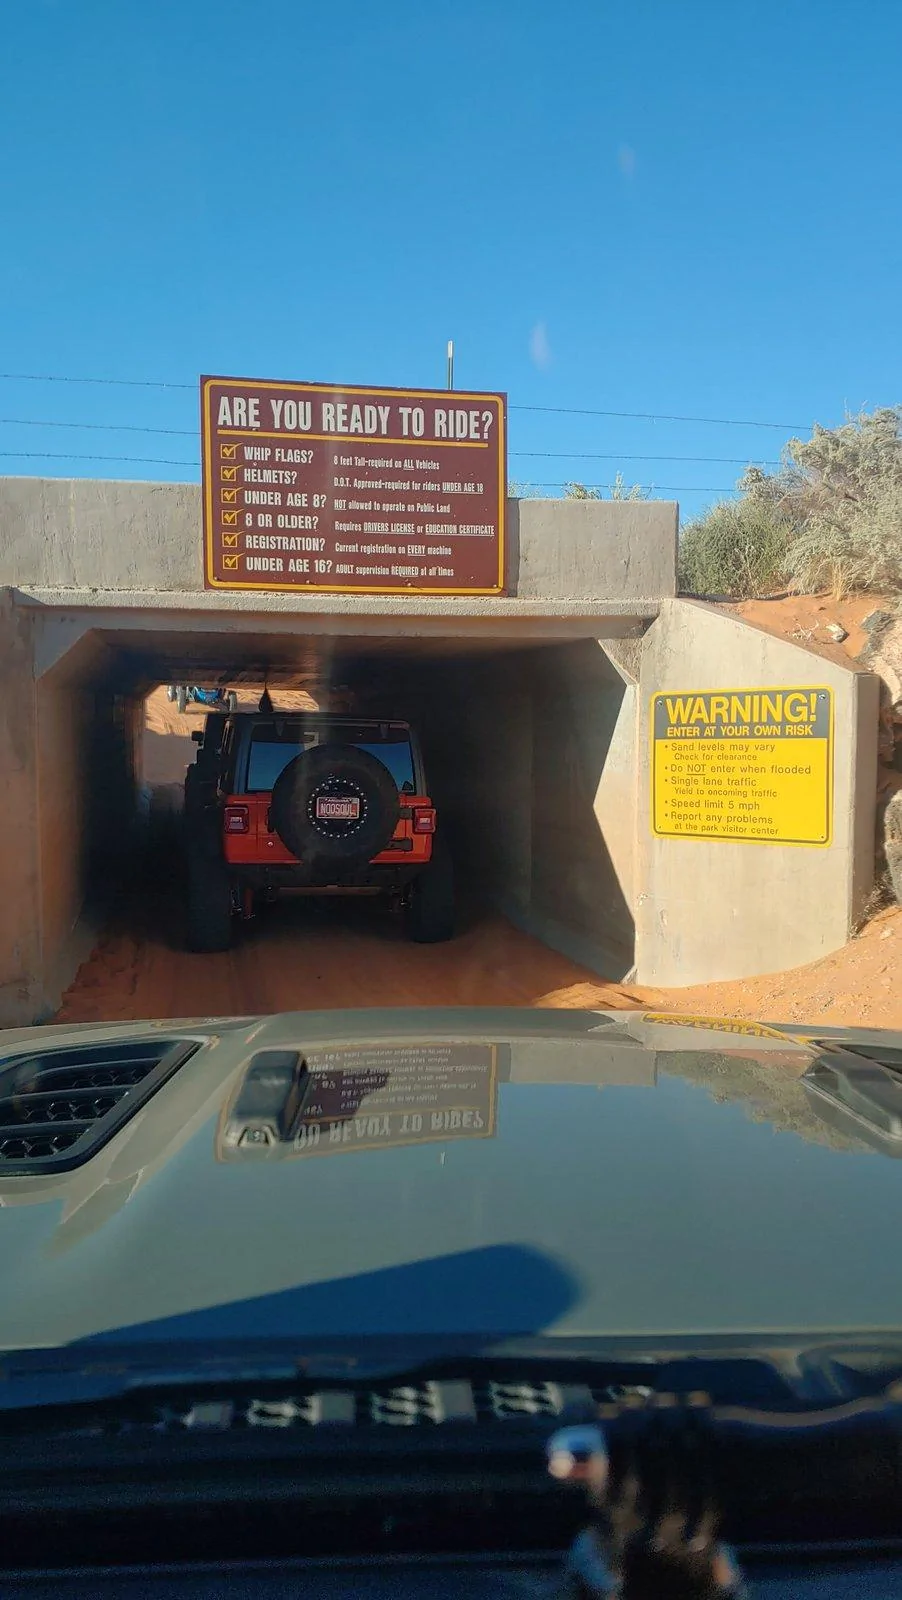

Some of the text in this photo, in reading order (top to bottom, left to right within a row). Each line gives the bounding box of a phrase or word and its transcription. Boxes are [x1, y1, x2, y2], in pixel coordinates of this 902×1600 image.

[217, 396, 493, 439] ARE YOU READY TO RIDE?
[244, 446, 313, 463] WHIP FLAGS?
[333, 456, 338, 464] 8
[340, 456, 352, 466] feet
[355, 456, 392, 468] Tall-required
[403, 459, 414, 469] ALL
[416, 460, 439, 470] Vehicles
[244, 469, 297, 484] HELMETS?
[334, 477, 483, 492] D.O.T. Approved-required for riders UNDER AGE 18
[244, 491, 326, 507] UNDER AGE 8?
[334, 500, 346, 509] NOT
[348, 501, 371, 510] allowed
[374, 501, 380, 511] to
[382, 503, 405, 512] operate
[417, 503, 434, 512] Public
[437, 504, 450, 513] Land
[245, 513, 318, 529] 8 OR OLDER?
[335, 521, 361, 532] Requires
[364, 522, 389, 532] DRIVERS
[391, 523, 414, 533] LICENSE
[425, 525, 457, 534] EDUCATION
[459, 526, 494, 535] CERTIFICATE
[246, 535, 325, 551] REGISTRATION?
[335, 543, 451, 555] Current registration on EVERY machine
[246, 557, 332, 573] UNDER AGE 16?
[336, 565, 354, 574] ADULT
[356, 566, 389, 576] supervision
[391, 566, 418, 576] REQUIRED
[421, 567, 426, 575] at
[438, 567, 454, 576] times
[666, 693, 817, 724] WARNING!
[667, 725, 813, 737] ENTER AT YOUR OWN RISK
[671, 743, 775, 753] Sand levels may vary
[717, 753, 757, 761] clearance
[670, 764, 683, 772] Do
[687, 764, 706, 773] NOT
[740, 765, 765, 773] when
[771, 765, 811, 774] flooded
[671, 776, 698, 786] Single
[727, 778, 757, 786] traffic
[708, 789, 748, 798] oncoming
[752, 789, 777, 797] traffic
[671, 799, 760, 811] Speed limit 5 mph
[670, 812, 773, 824] Report any problems
[701, 824, 718, 832] park
[722, 825, 747, 833] visitor
[751, 827, 778, 835] center
